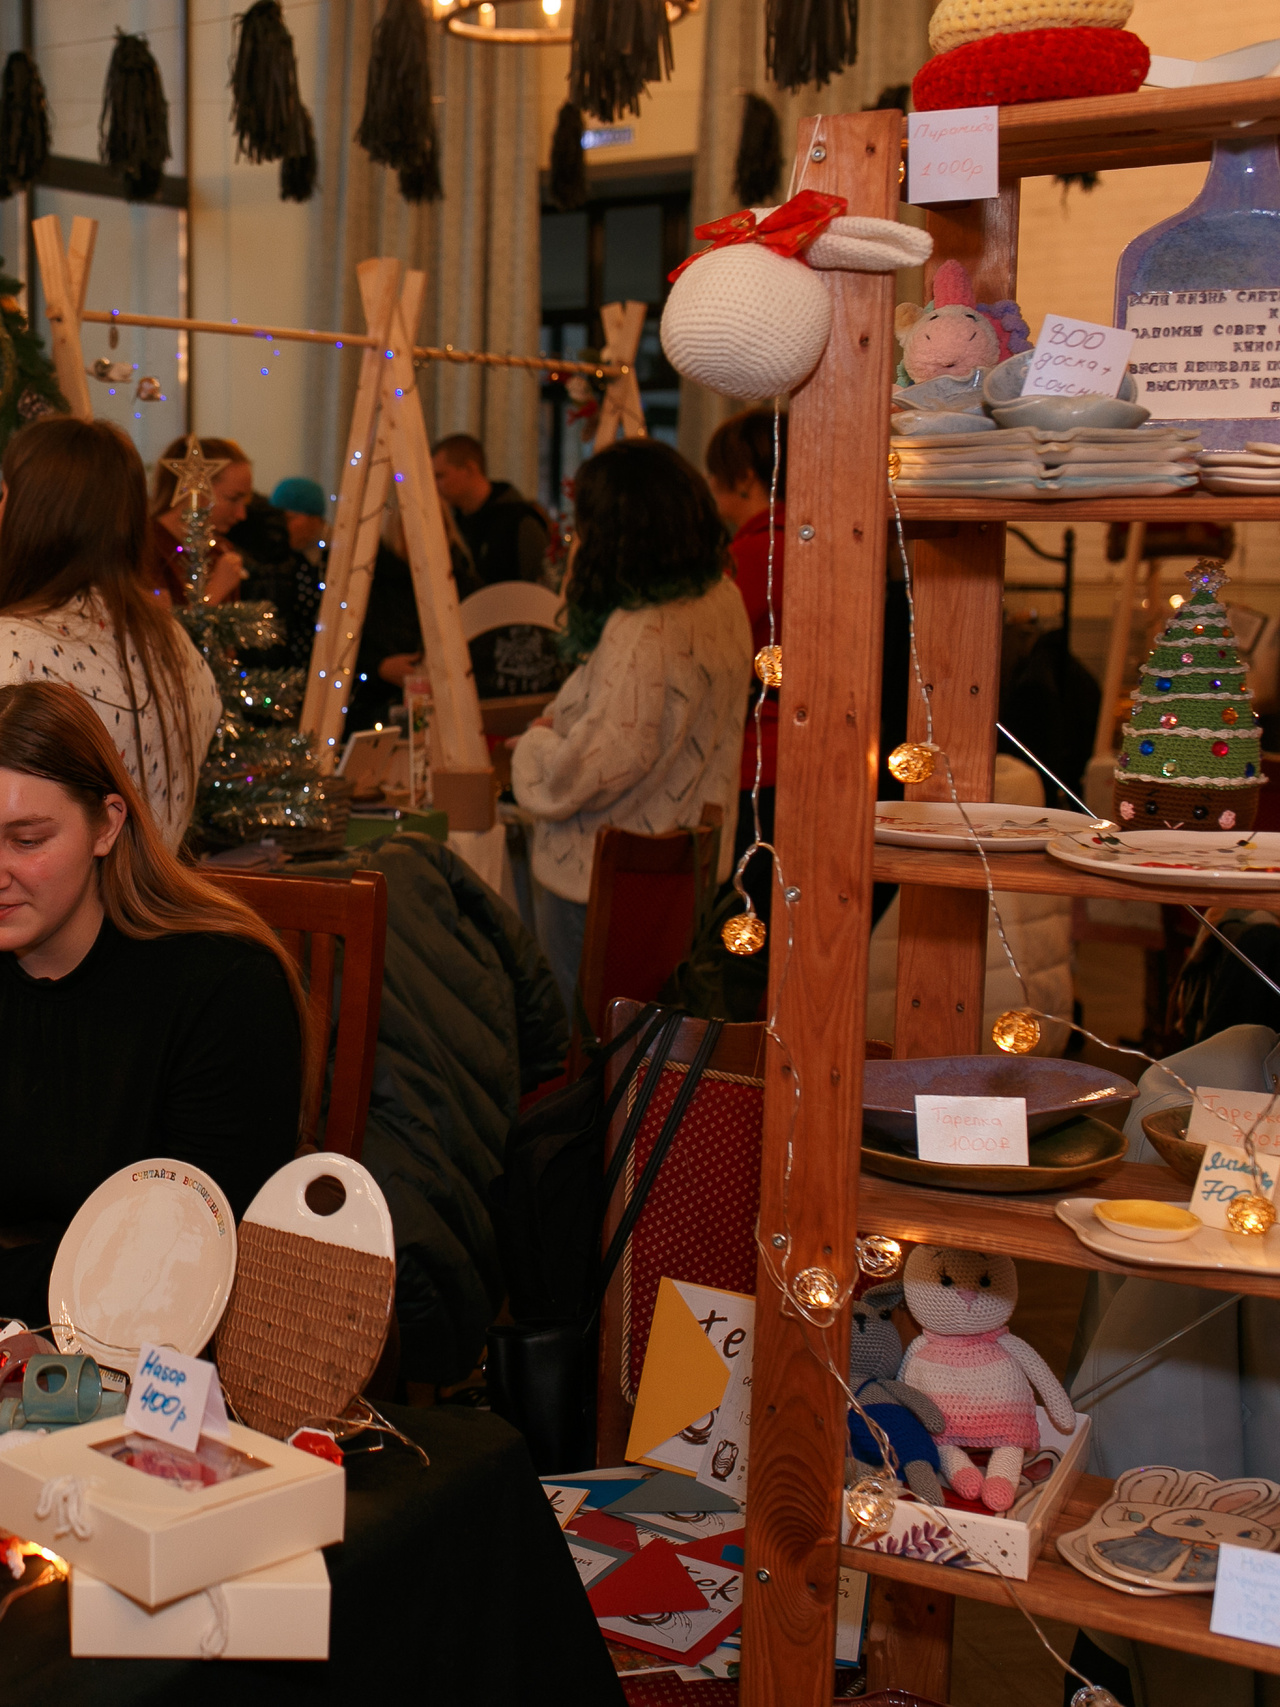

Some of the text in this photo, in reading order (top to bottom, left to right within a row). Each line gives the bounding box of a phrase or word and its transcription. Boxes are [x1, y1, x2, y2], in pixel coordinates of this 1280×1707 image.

[1214, 324, 1266, 335] СОВЕТ
[1129, 361, 1178, 374] ВИСКИ
[1146, 378, 1240, 392] ВЫСЛУШАТЬ
[140, 1349, 186, 1387] Набор
[140, 1382, 187, 1433] 400р
